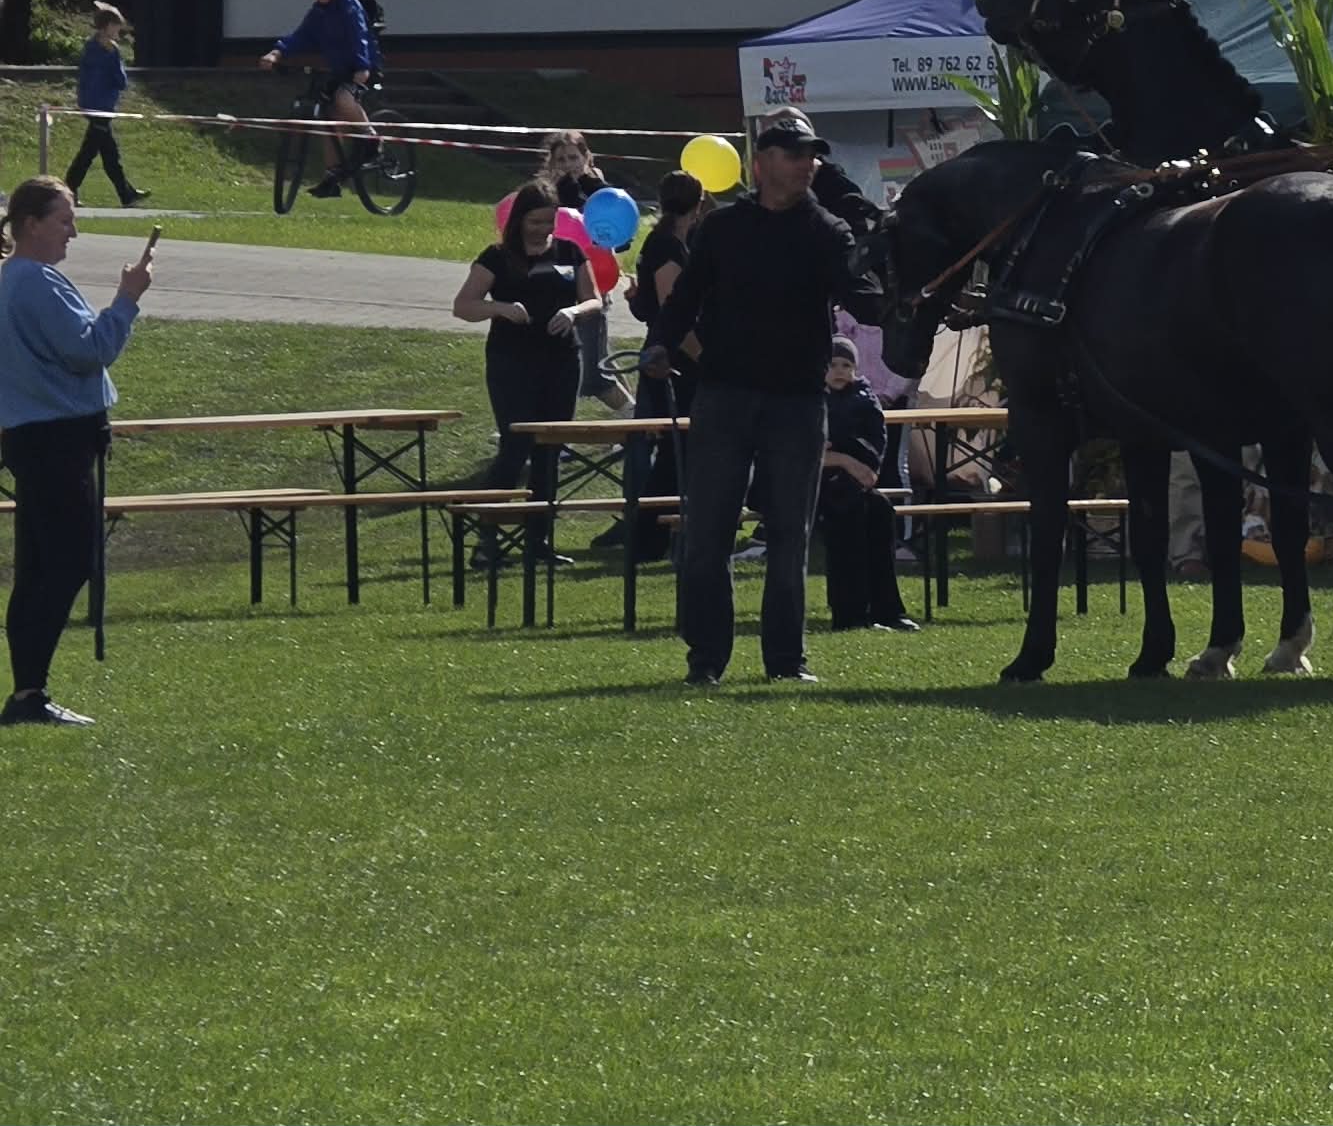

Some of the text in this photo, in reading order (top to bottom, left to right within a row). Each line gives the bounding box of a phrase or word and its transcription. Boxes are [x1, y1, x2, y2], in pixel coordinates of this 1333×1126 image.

[917, 57, 933, 72] 89
[938, 56, 961, 72] 762
[966, 55, 981, 71] 62
[986, 55, 999, 71] 6
